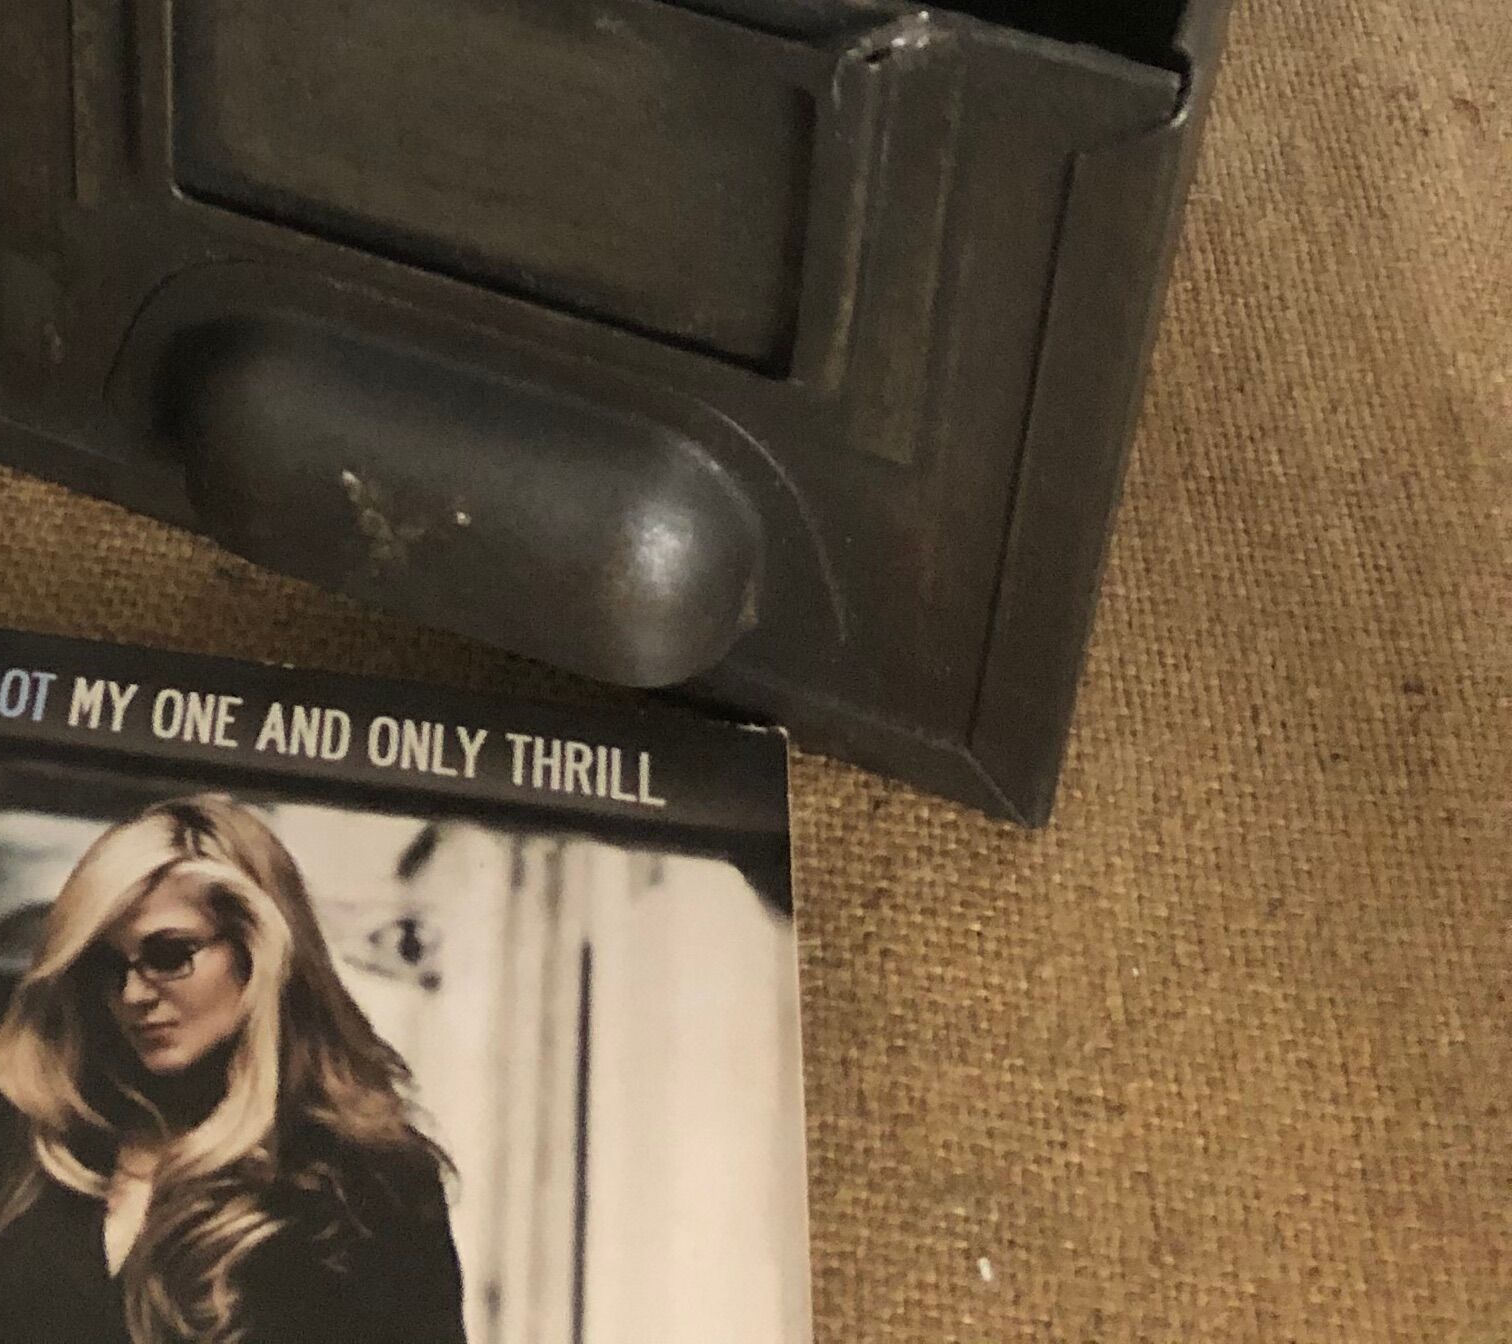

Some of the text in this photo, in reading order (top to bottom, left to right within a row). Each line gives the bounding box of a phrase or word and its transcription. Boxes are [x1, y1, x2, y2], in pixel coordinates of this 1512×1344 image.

[66, 676, 140, 733] MY
[150, 688, 239, 751] ONE
[254, 701, 352, 764] AND
[365, 715, 491, 781] ONLY
[503, 732, 669, 808] THRILL
